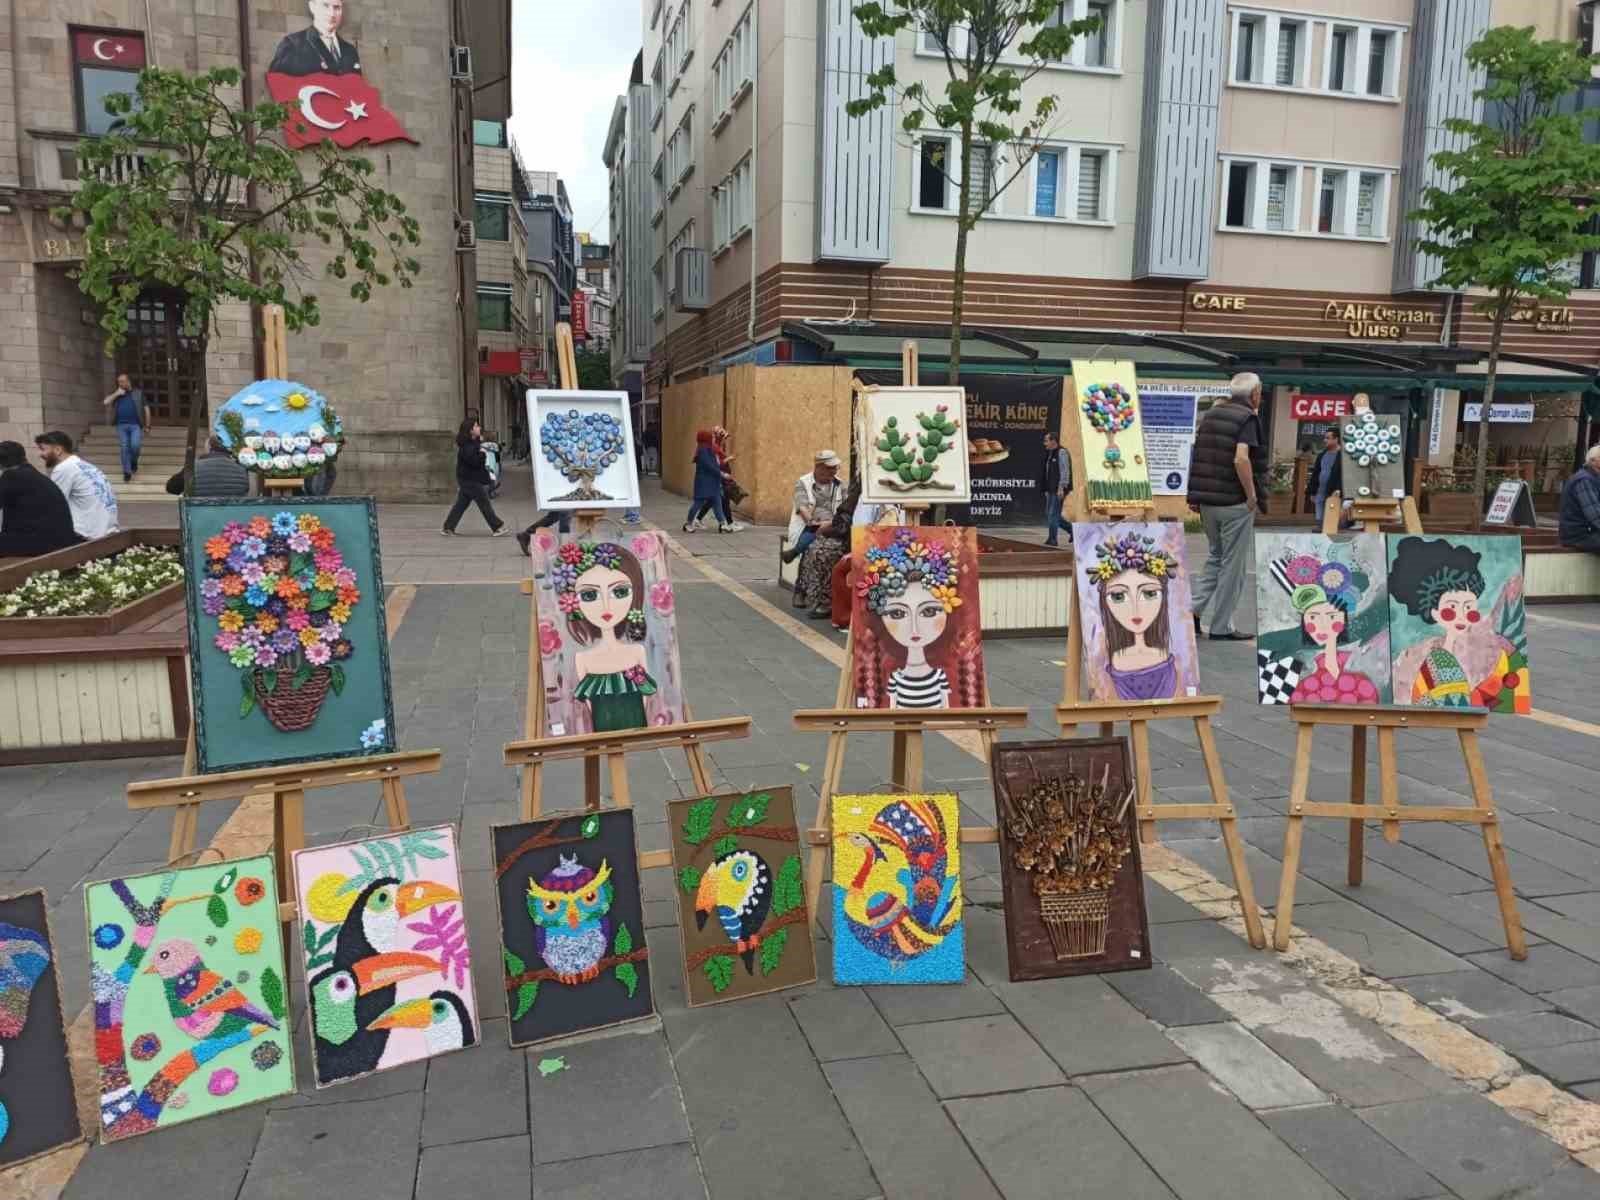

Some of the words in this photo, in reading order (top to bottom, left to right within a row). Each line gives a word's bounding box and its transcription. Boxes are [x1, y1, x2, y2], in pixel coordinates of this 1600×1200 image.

[1193, 292, 1246, 310] CAFE
[1348, 320, 1410, 338] Uluso
[966, 401, 1001, 420] EKİR
[1295, 399, 1346, 416] CAFE
[971, 477, 1037, 488] CRÜBESİYLE
[972, 492, 1012, 502] AKINDA
